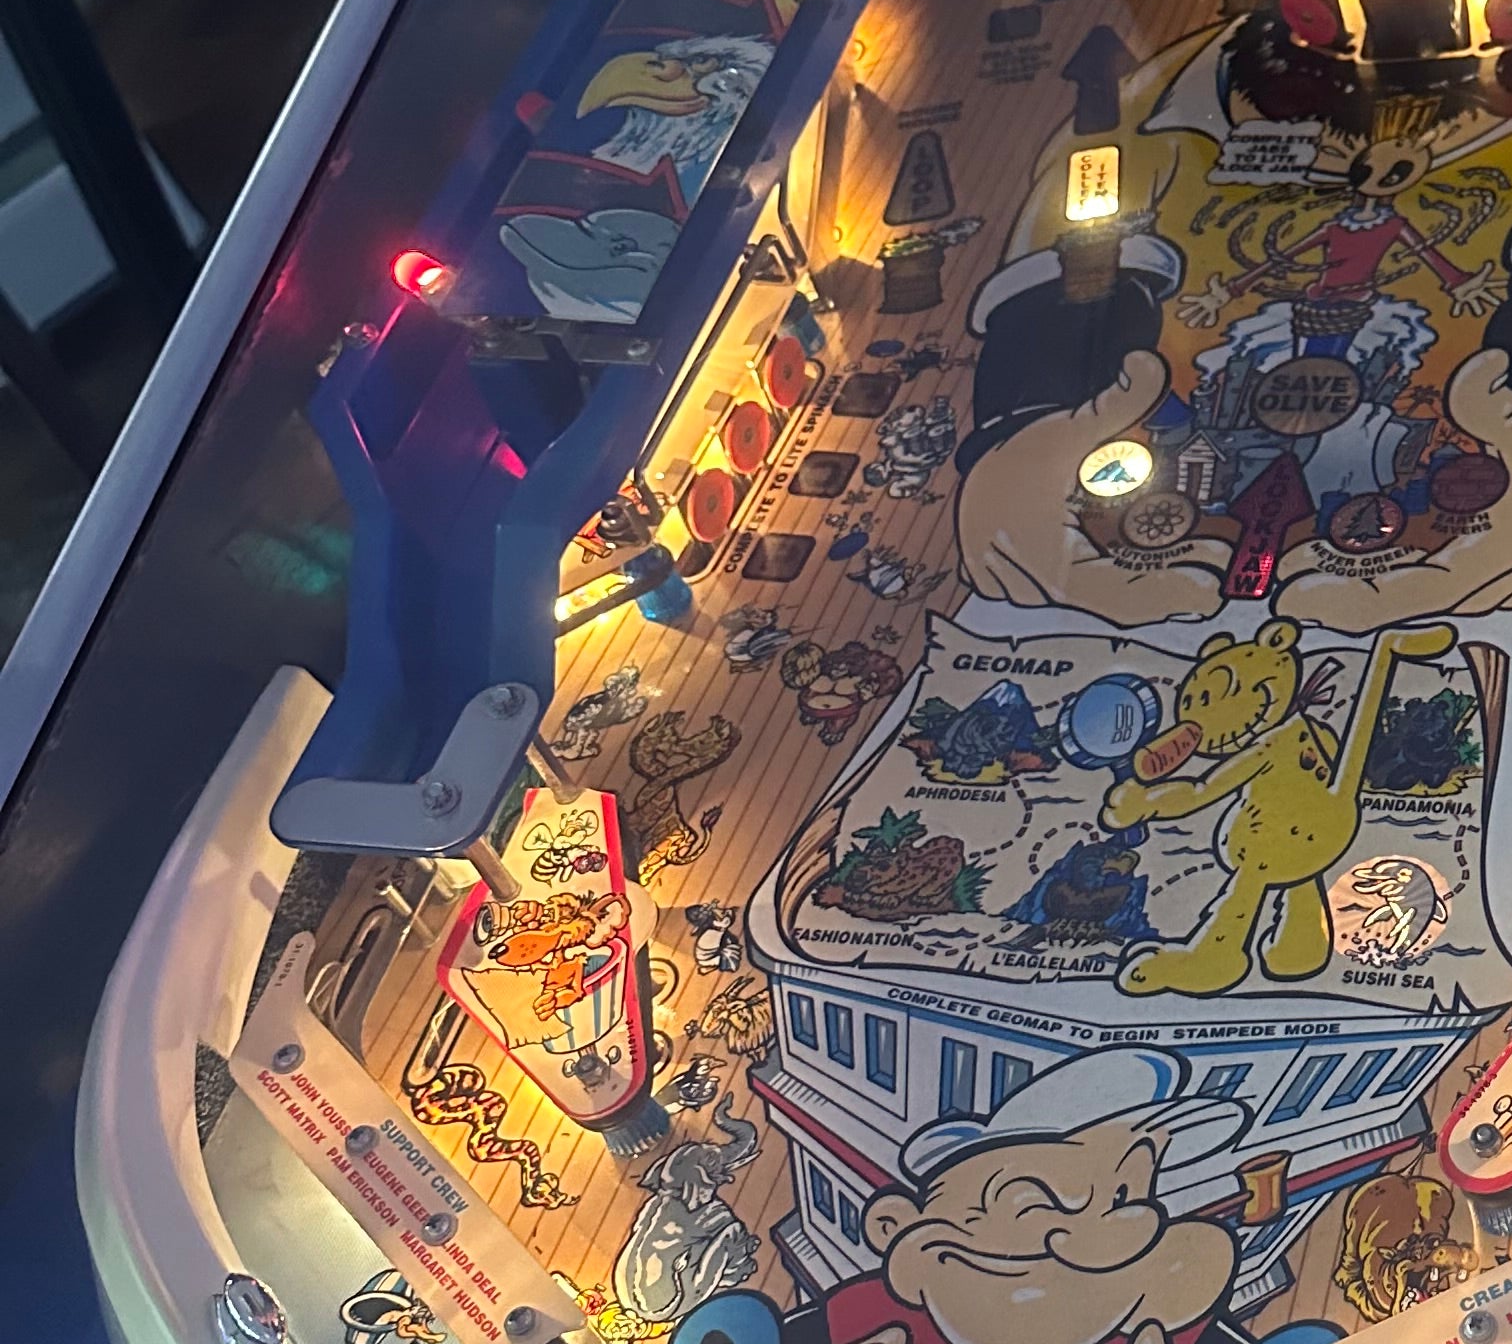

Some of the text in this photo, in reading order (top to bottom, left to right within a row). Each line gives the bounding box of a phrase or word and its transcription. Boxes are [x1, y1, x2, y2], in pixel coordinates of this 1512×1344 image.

[1272, 375, 1350, 394] SAVE
[1258, 394, 1351, 413] OLIVE
[724, 374, 843, 573] COMPLETE TO LITE SPINACH
[1113, 558, 1164, 571] WASTE
[1310, 542, 1416, 567] NEVER GREEN
[1317, 558, 1388, 578] LOGGING
[952, 653, 1075, 679] GEOMAP
[904, 786, 1007, 804] APHRODESIA
[1362, 797, 1474, 818] PANDAMONIA
[790, 927, 915, 948] FASHIONATION
[991, 951, 1105, 975] L'EAGLELAND
[1342, 969, 1436, 990] SUSHI SEA
[887, 987, 1341, 1043] COMPLETE GEOMAP TO BEGIN STAMPEDE MODE
[379, 1118, 469, 1214] SUPPORT CREW
[291, 1073, 503, 1305] JOHN YOUSS EUGENE LINDA DEAL
[257, 1069, 502, 1342] SCOTT MATRIX PAM ERICKSON MARGARET HUDSON
